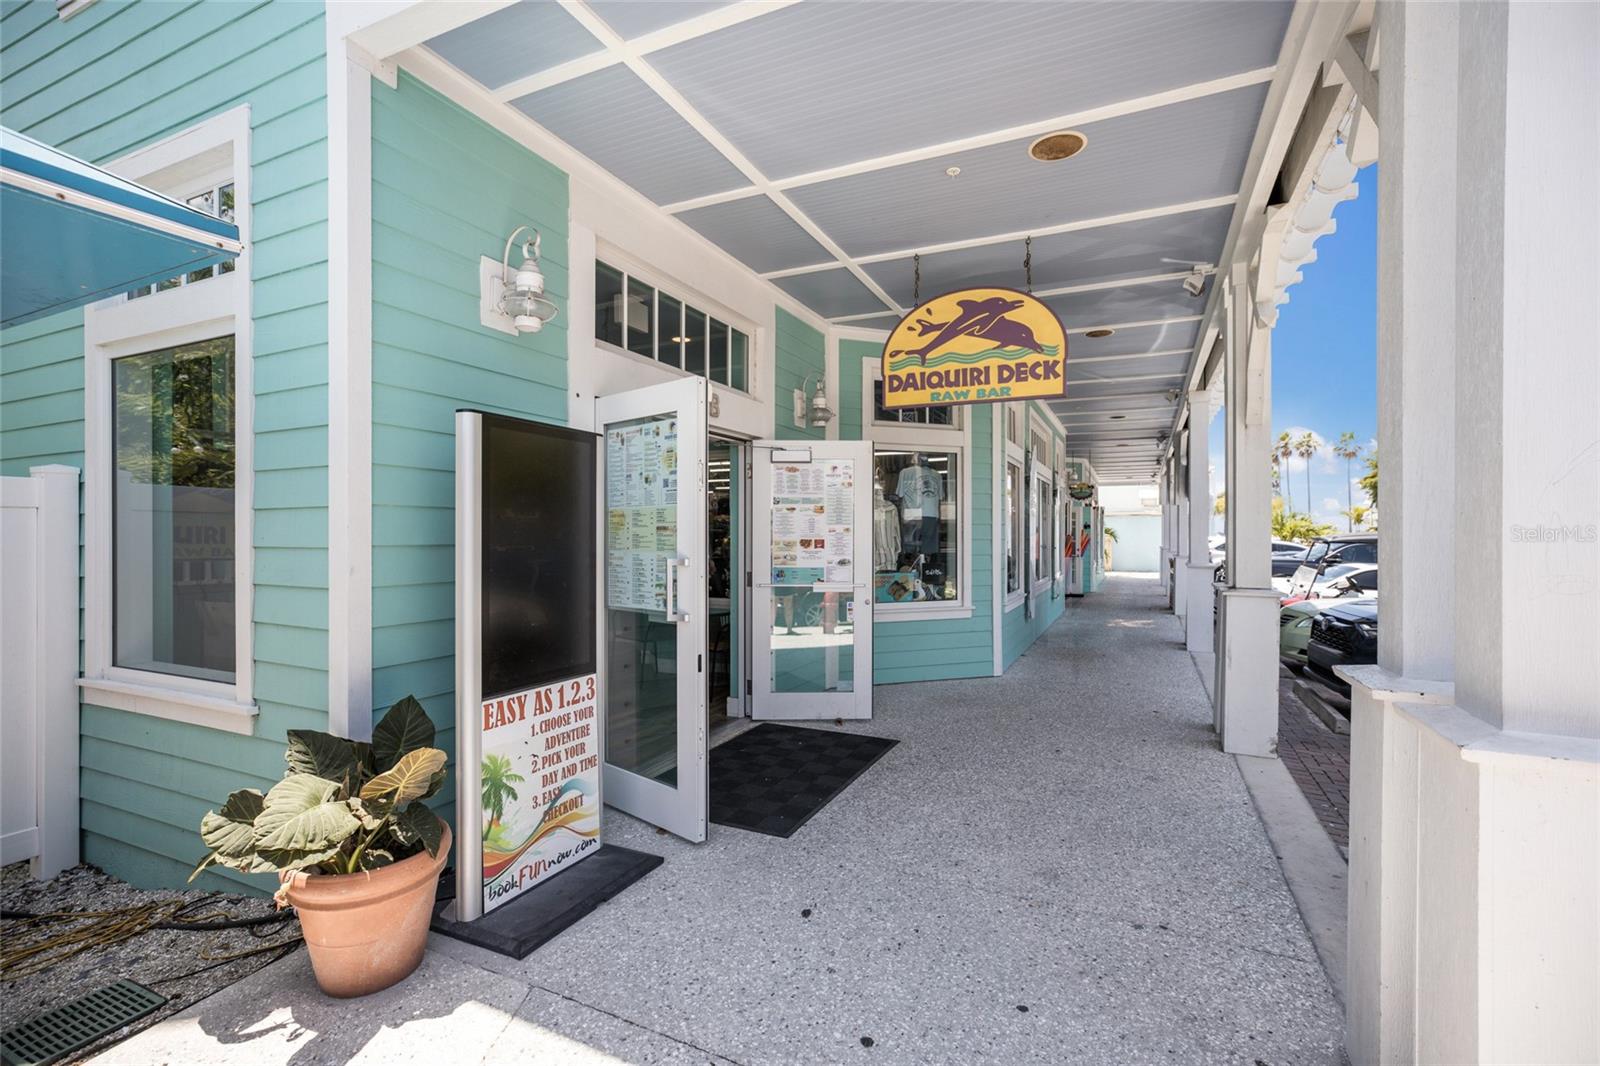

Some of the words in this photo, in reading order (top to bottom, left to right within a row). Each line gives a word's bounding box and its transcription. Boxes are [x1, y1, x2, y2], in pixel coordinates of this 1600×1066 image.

[888, 366, 990, 393] DAIQUIRI
[997, 360, 1061, 384] DECK
[930, 389, 970, 402] RAW
[976, 386, 1011, 398] BAR
[483, 694, 528, 731] EASY
[533, 688, 553, 717] AS
[557, 677, 596, 710] 1.2.3
[530, 724, 539, 737] 1.
[539, 714, 573, 735] CHOOSE
[573, 705, 594, 724] YOUR
[544, 723, 591, 752] ADVENTURE
[531, 759, 541, 774] 2.
[541, 750, 562, 769] PICK
[564, 742, 586, 760] YOUR
[541, 772, 559, 789] DAY
[561, 764, 578, 780] AND
[580, 754, 598, 773] TIME
[532, 795, 541, 810] 3.
[542, 786, 562, 807] EASY
[543, 793, 585, 824] CHECKOUT
